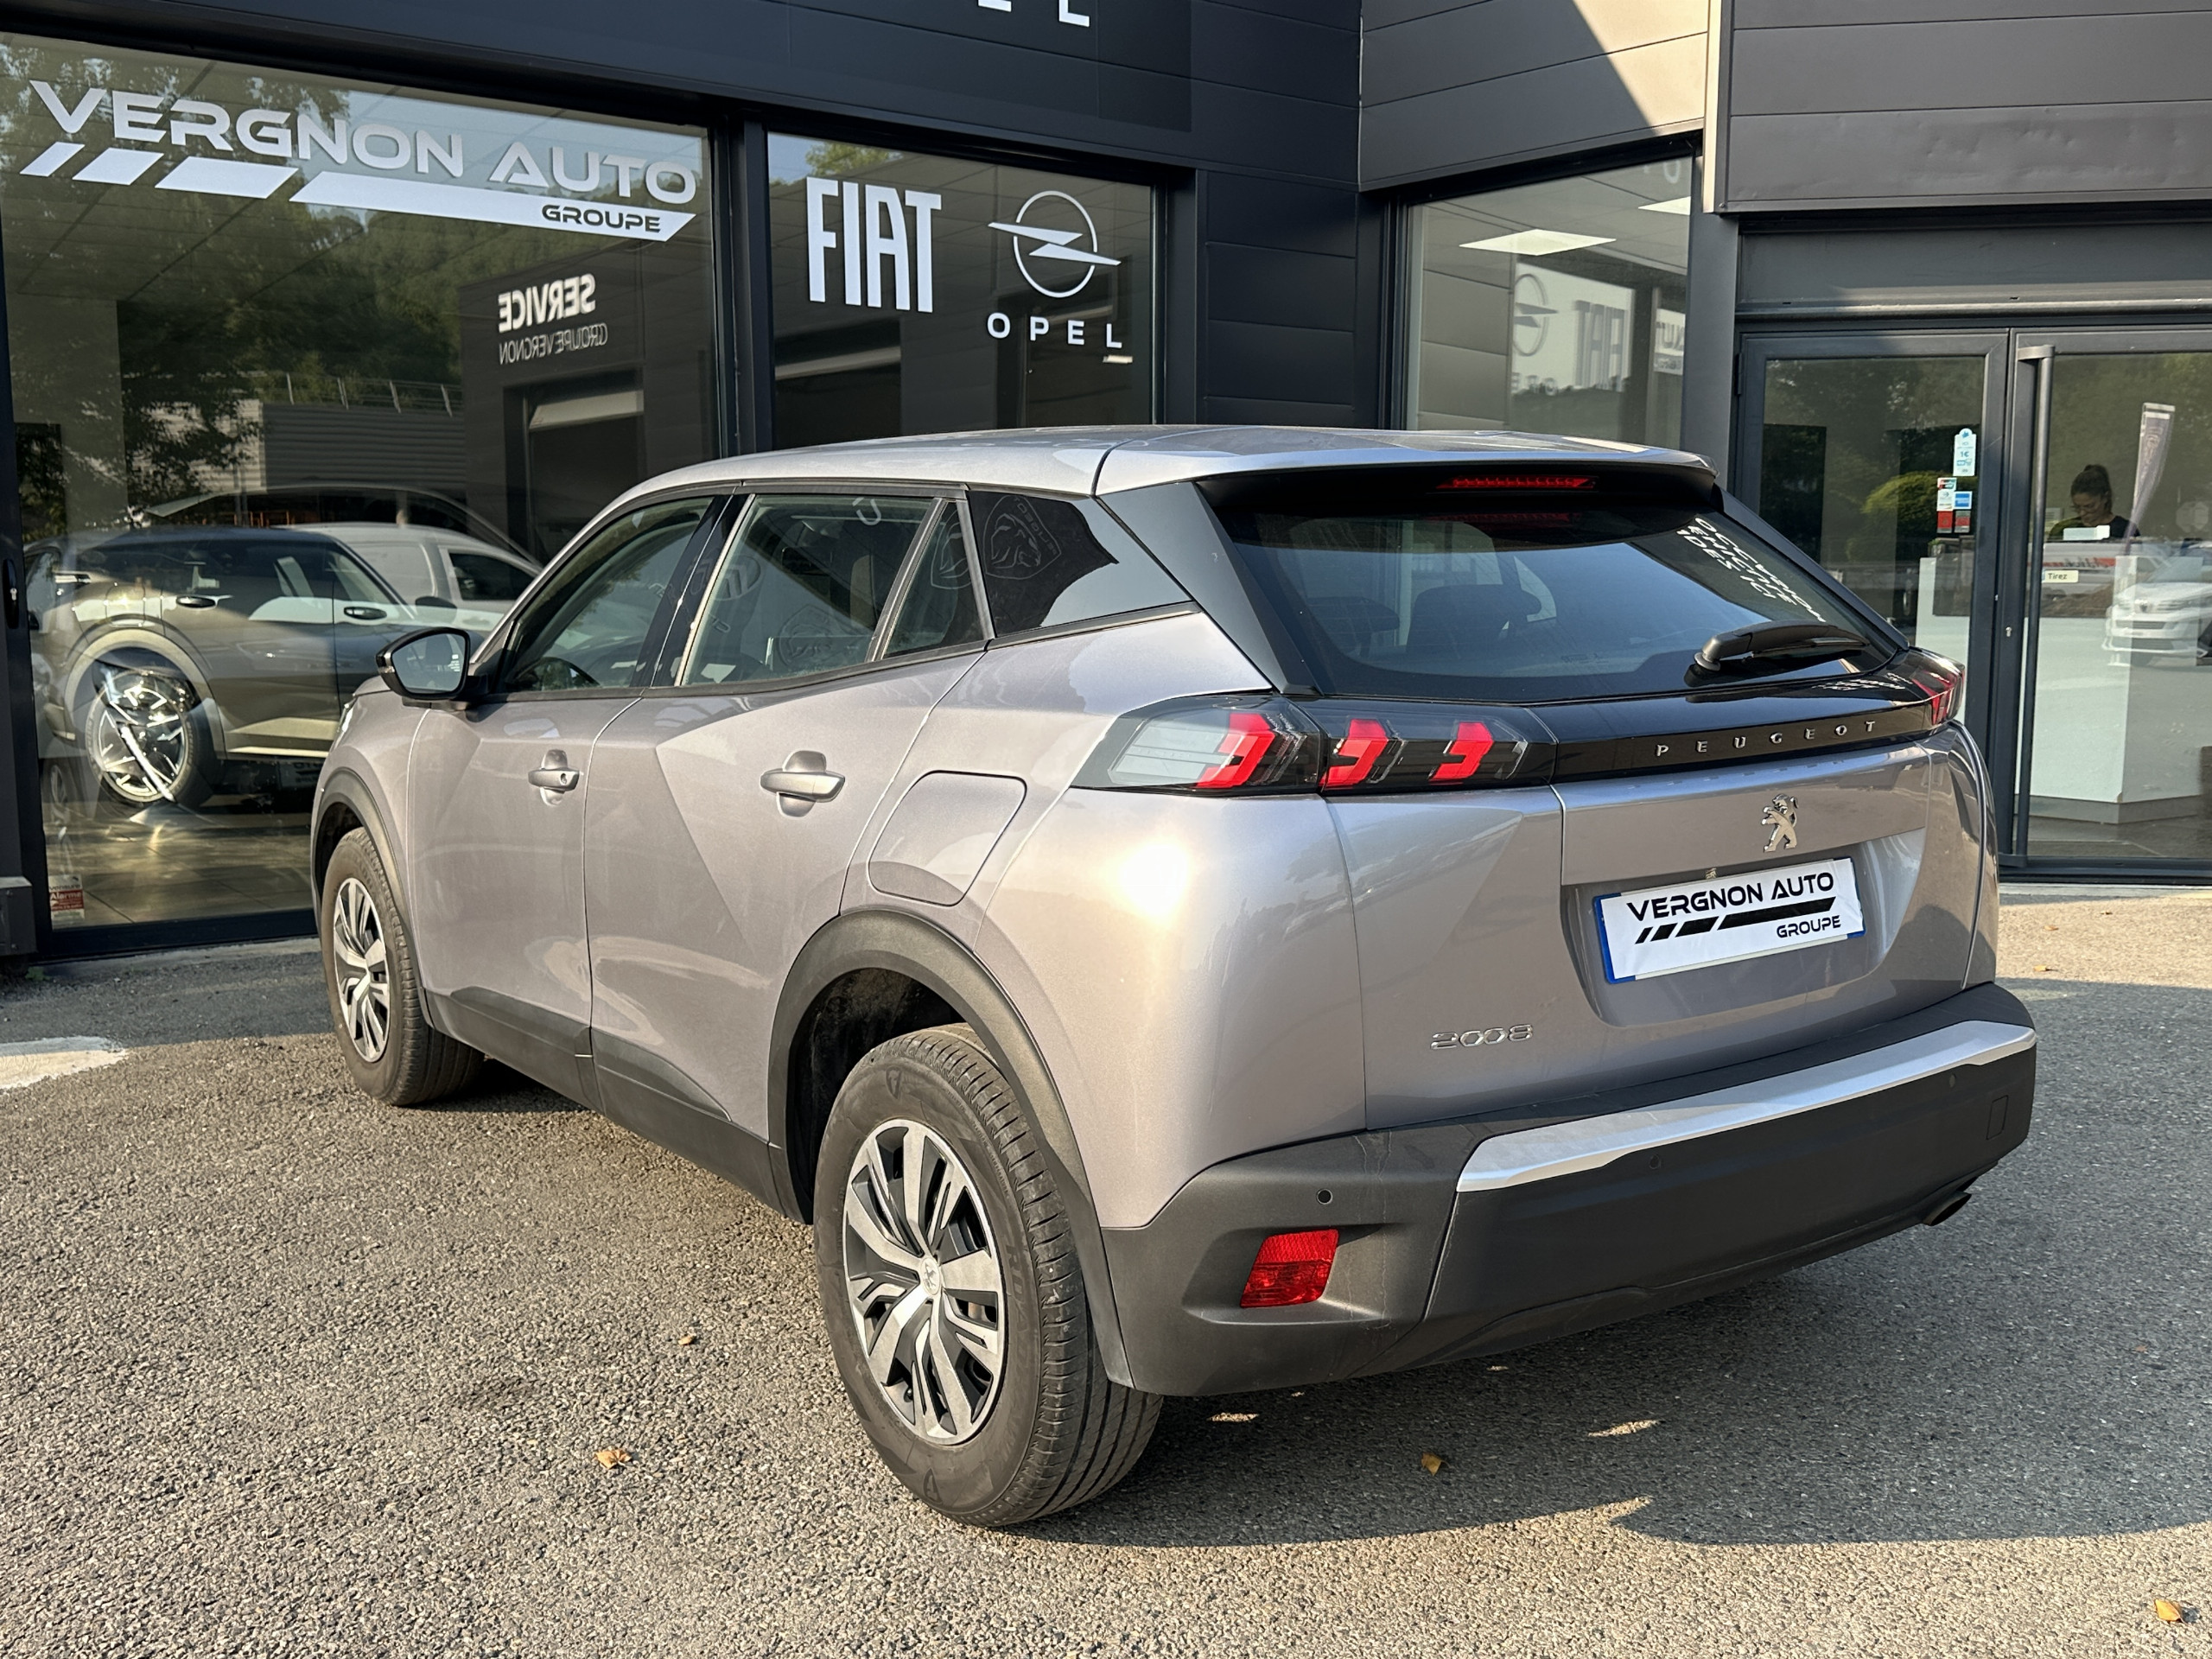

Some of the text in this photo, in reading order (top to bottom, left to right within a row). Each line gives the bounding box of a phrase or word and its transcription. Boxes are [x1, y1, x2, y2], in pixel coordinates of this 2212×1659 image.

[29, 80, 696, 204] VERGNON AUTO
[542, 204, 661, 233] GROUPE
[806, 176, 942, 313] FIAT
[987, 312, 1122, 348] OPEL
[1656, 721, 1876, 757] PEUGEOT
[1626, 872, 1834, 921] VERGNON AUTO
[1776, 914, 1841, 938] GROUPE
[1430, 1024, 1533, 1050] 2008
